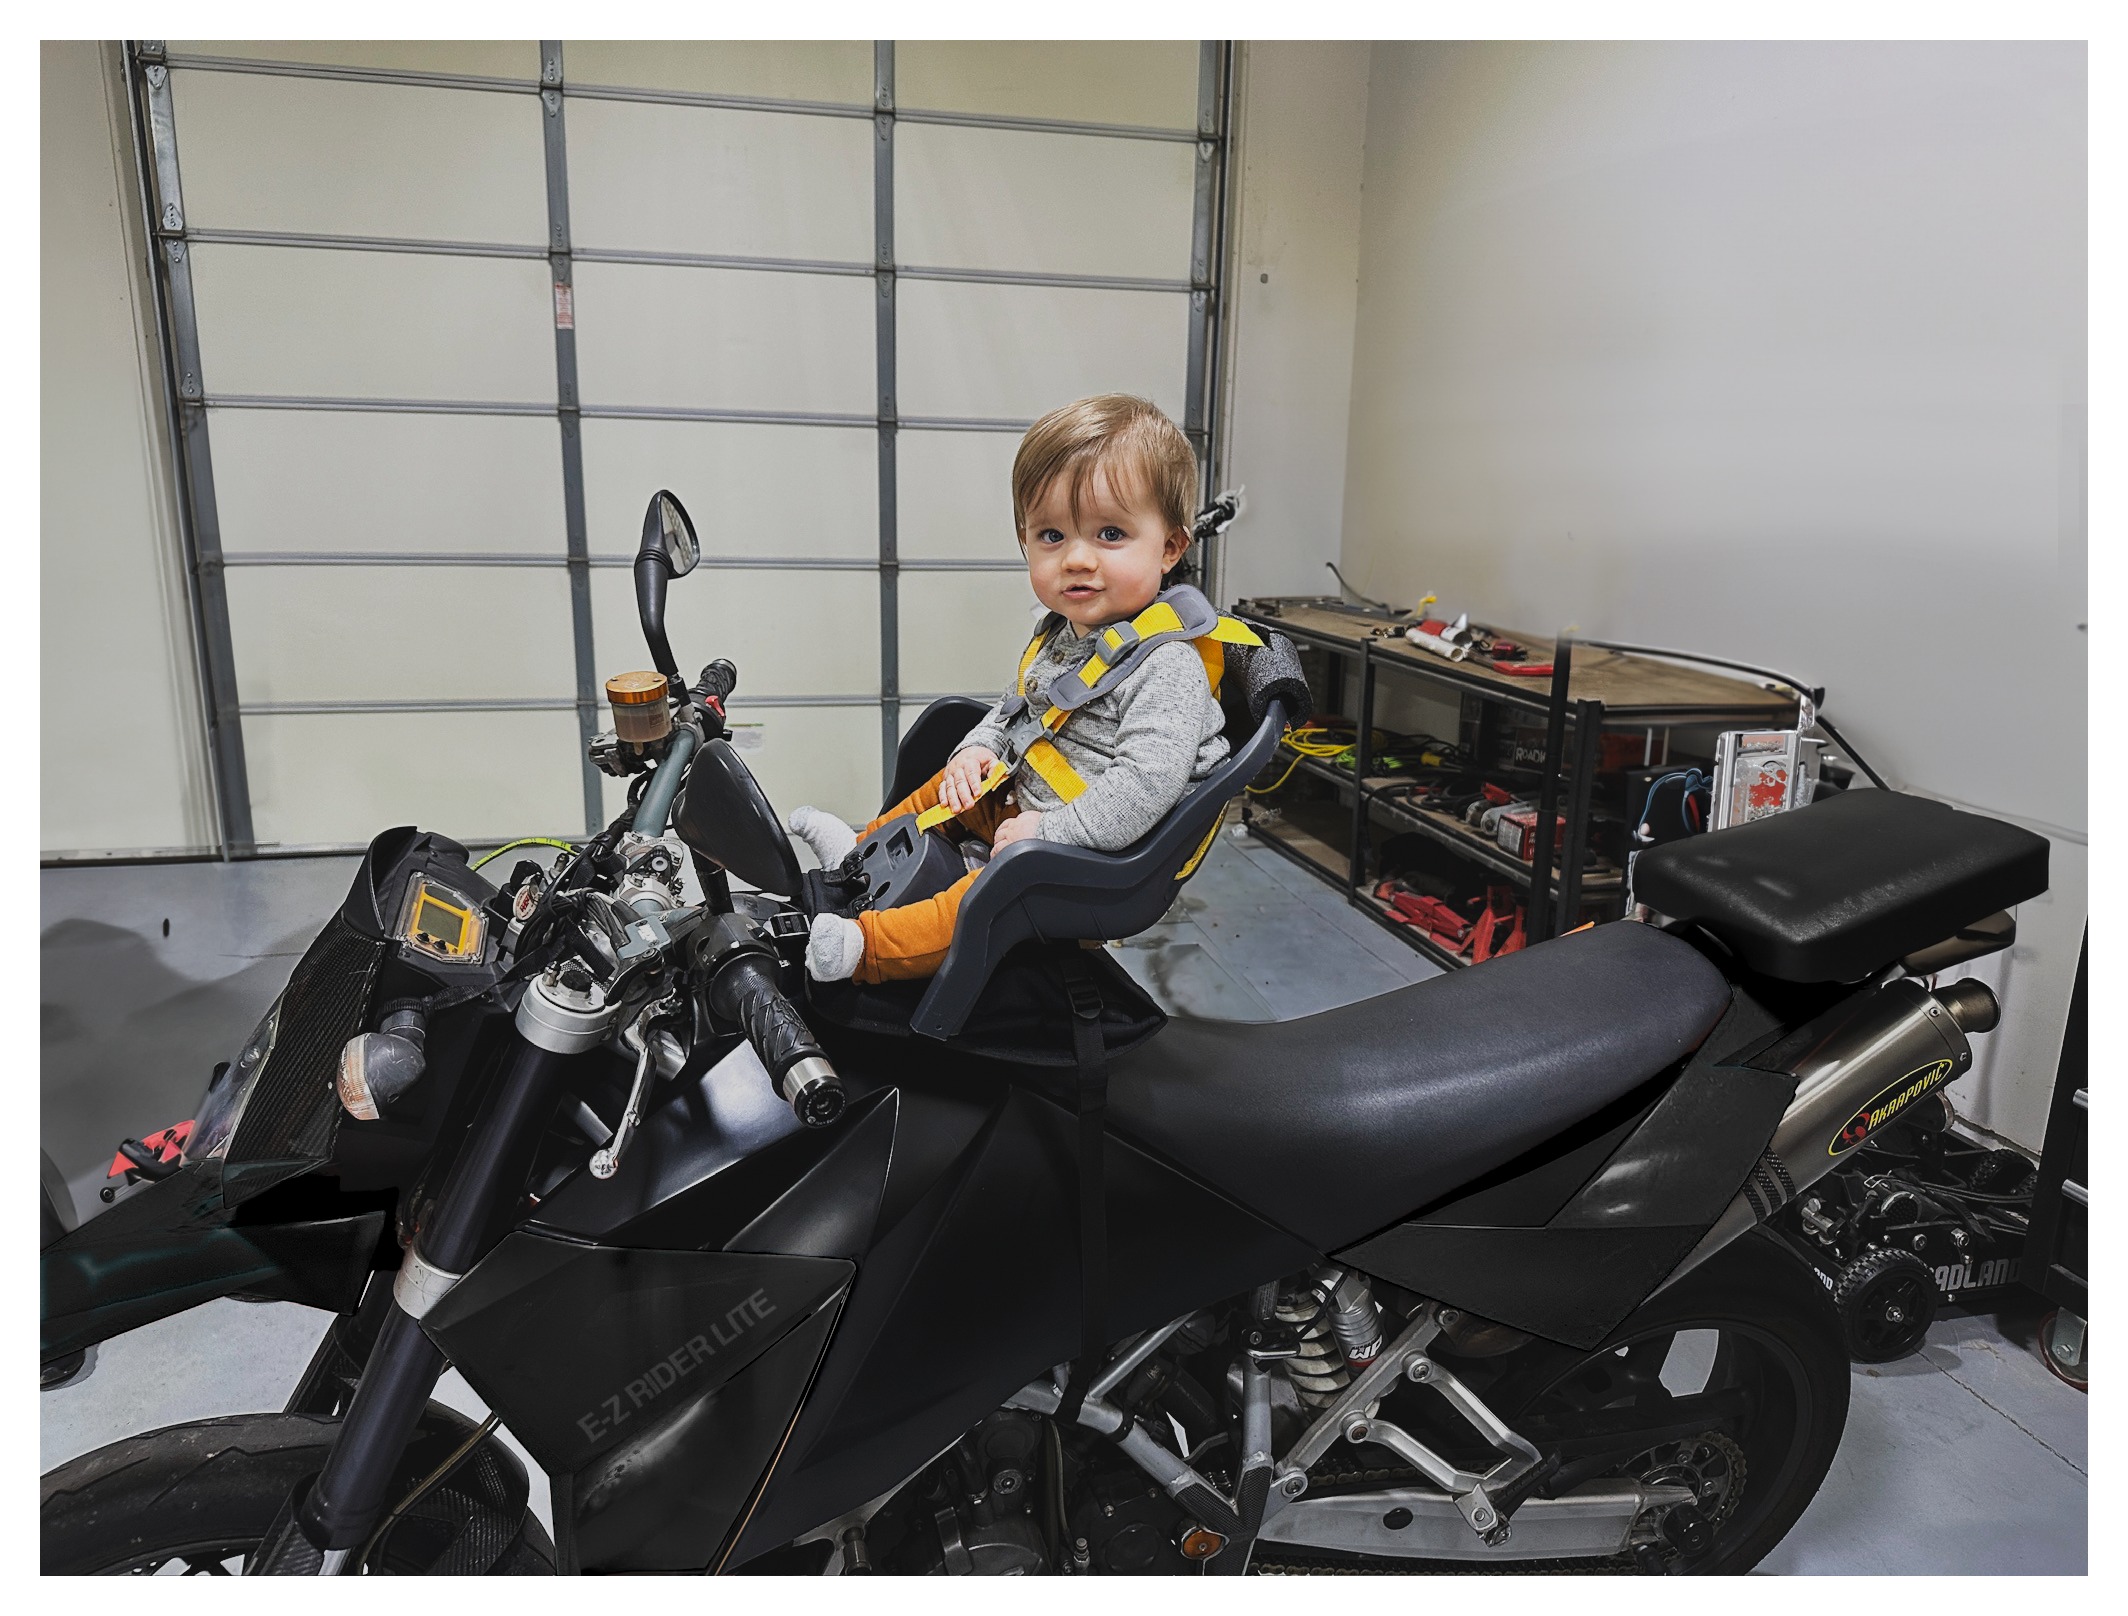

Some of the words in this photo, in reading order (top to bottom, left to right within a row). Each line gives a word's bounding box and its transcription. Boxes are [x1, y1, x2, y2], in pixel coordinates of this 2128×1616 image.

[1934, 1258, 2021, 1292] ADLAND
[1348, 1334, 1383, 1359] WP
[575, 1394, 631, 1443] E-Z
[624, 1335, 716, 1408] RIDER
[710, 1288, 778, 1346] LITE
